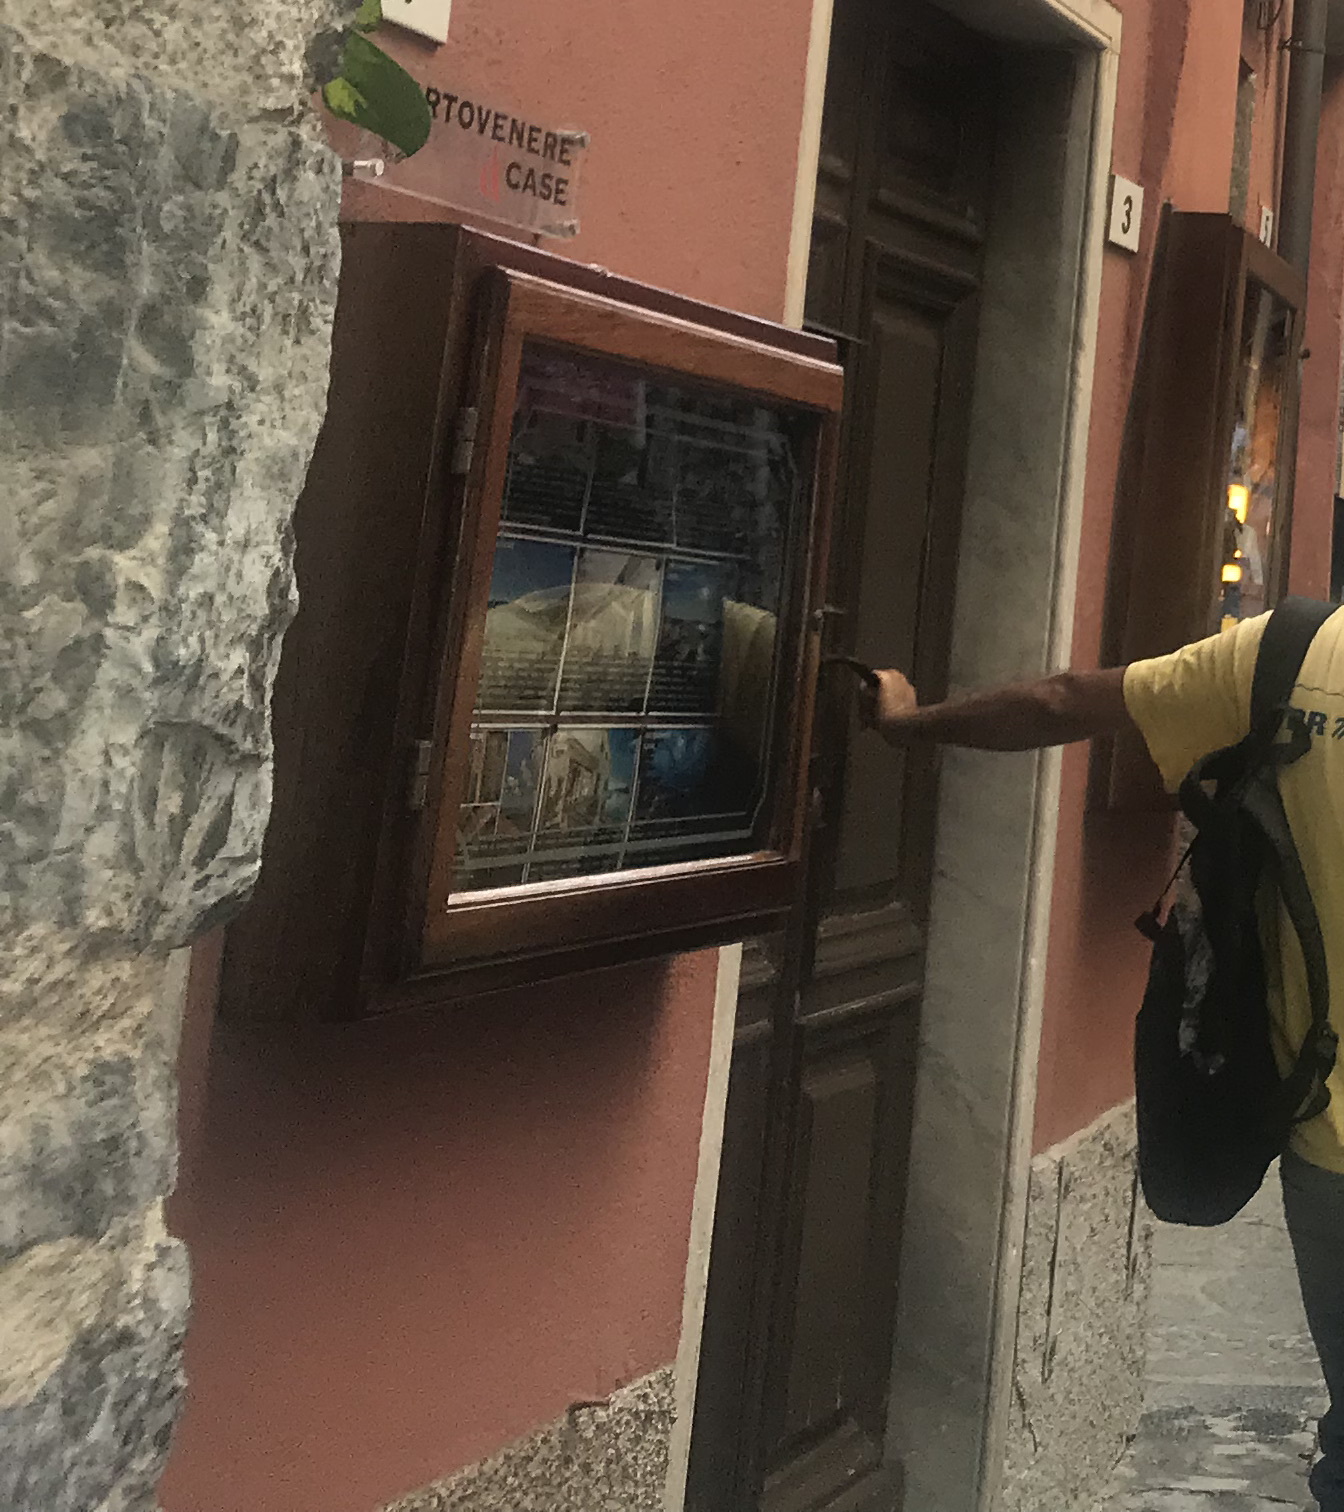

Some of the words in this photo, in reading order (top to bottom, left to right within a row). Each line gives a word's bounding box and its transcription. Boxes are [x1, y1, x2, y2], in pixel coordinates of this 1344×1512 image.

[425, 86, 575, 167] RTOVENERE
[505, 161, 570, 206] CASE
[1121, 194, 1133, 235] 3
